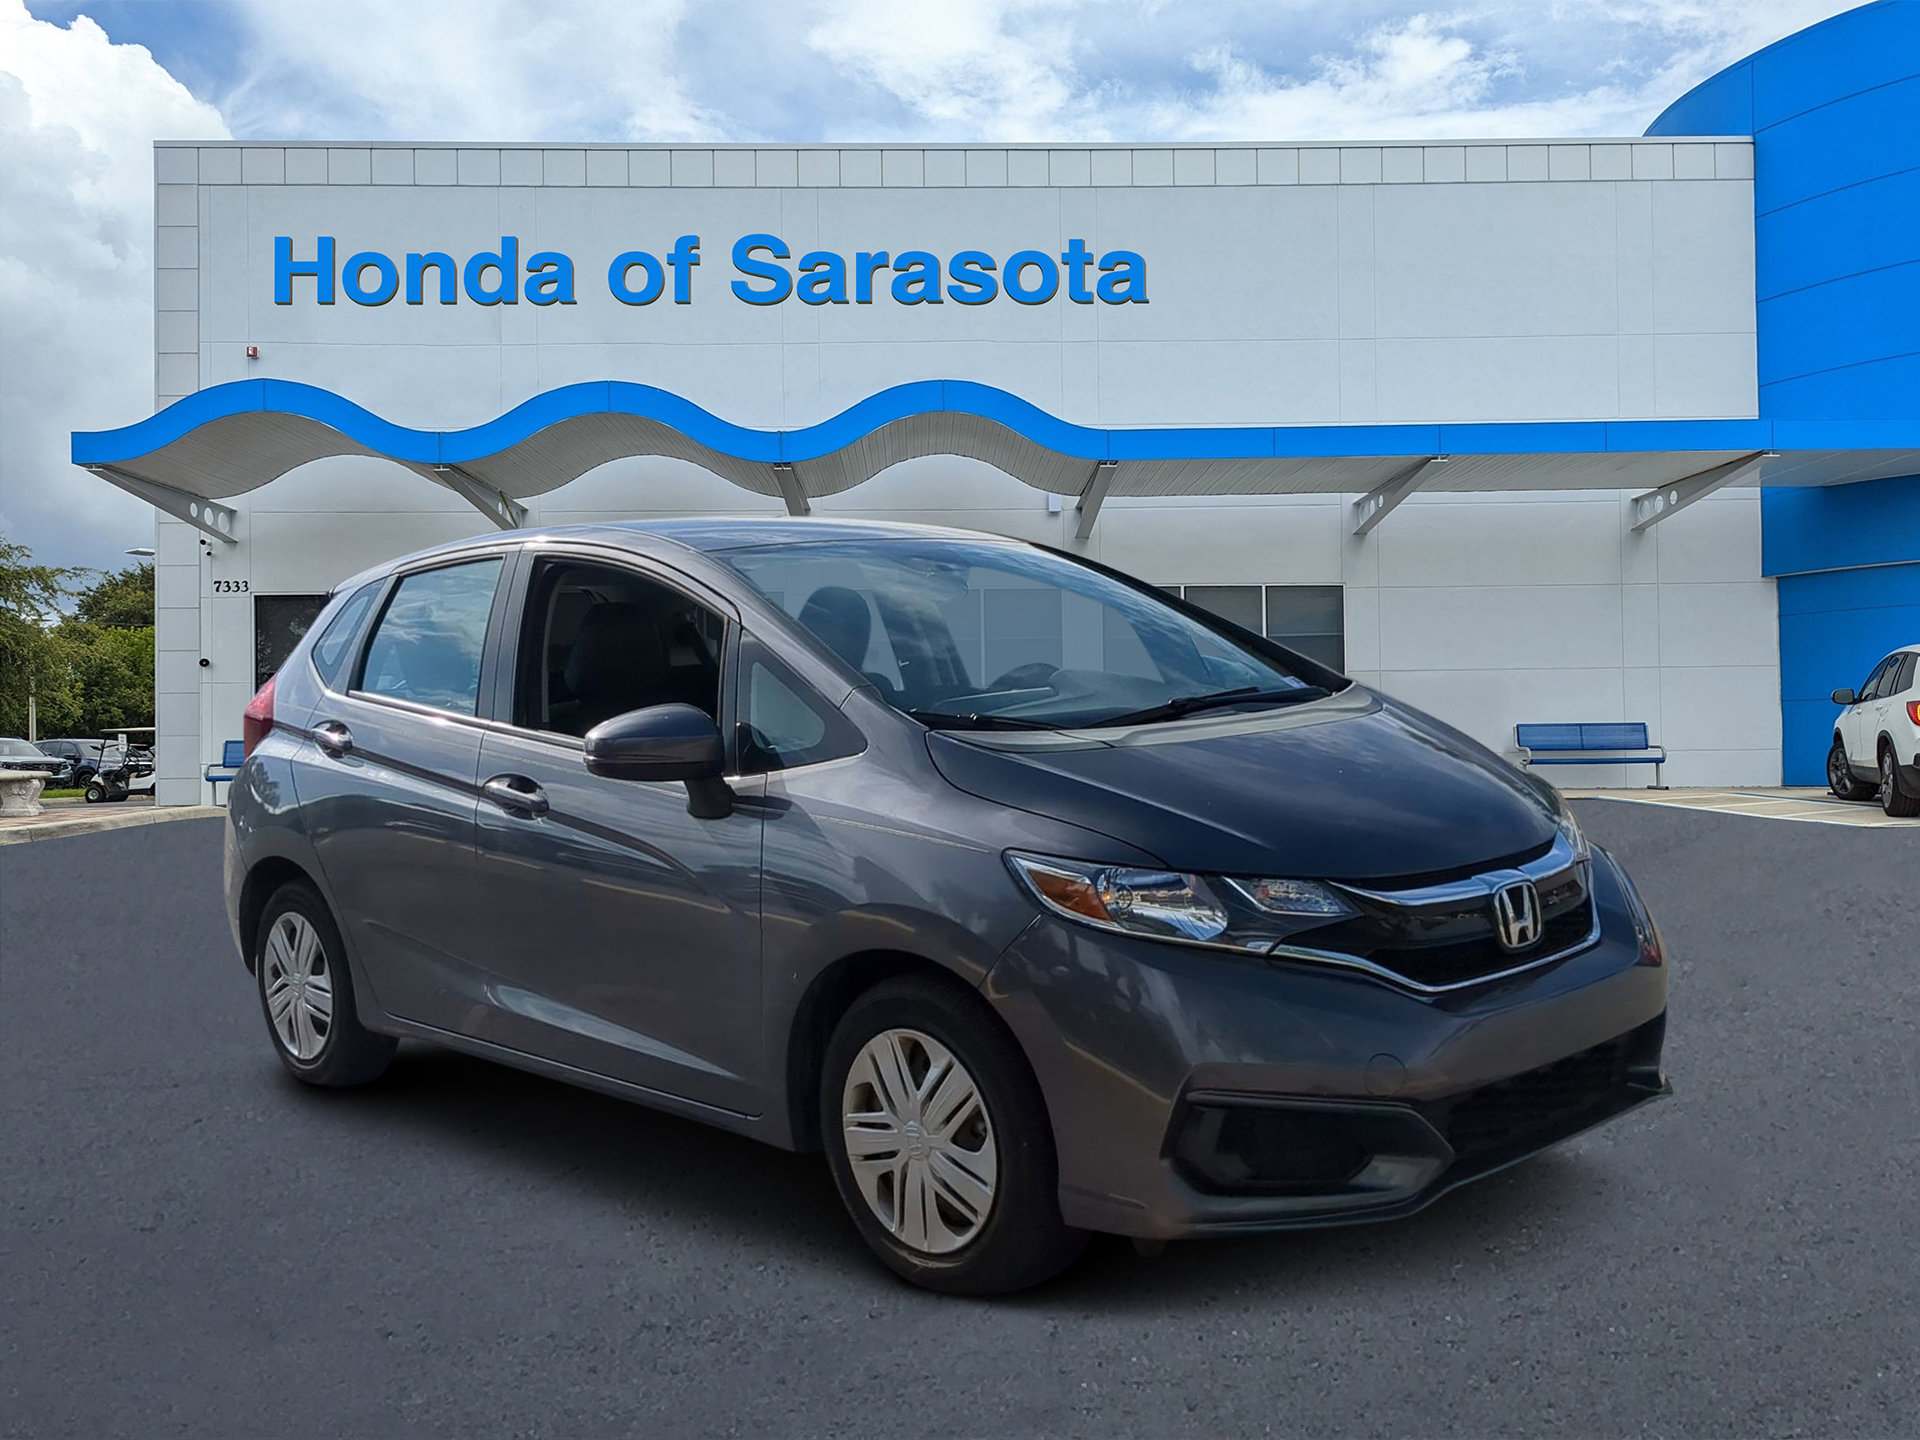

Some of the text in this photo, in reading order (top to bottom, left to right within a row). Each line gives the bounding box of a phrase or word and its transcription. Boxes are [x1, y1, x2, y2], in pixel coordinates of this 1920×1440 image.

[274, 234, 1149, 306] Honda of Sarasota
[213, 580, 249, 593] 7333
